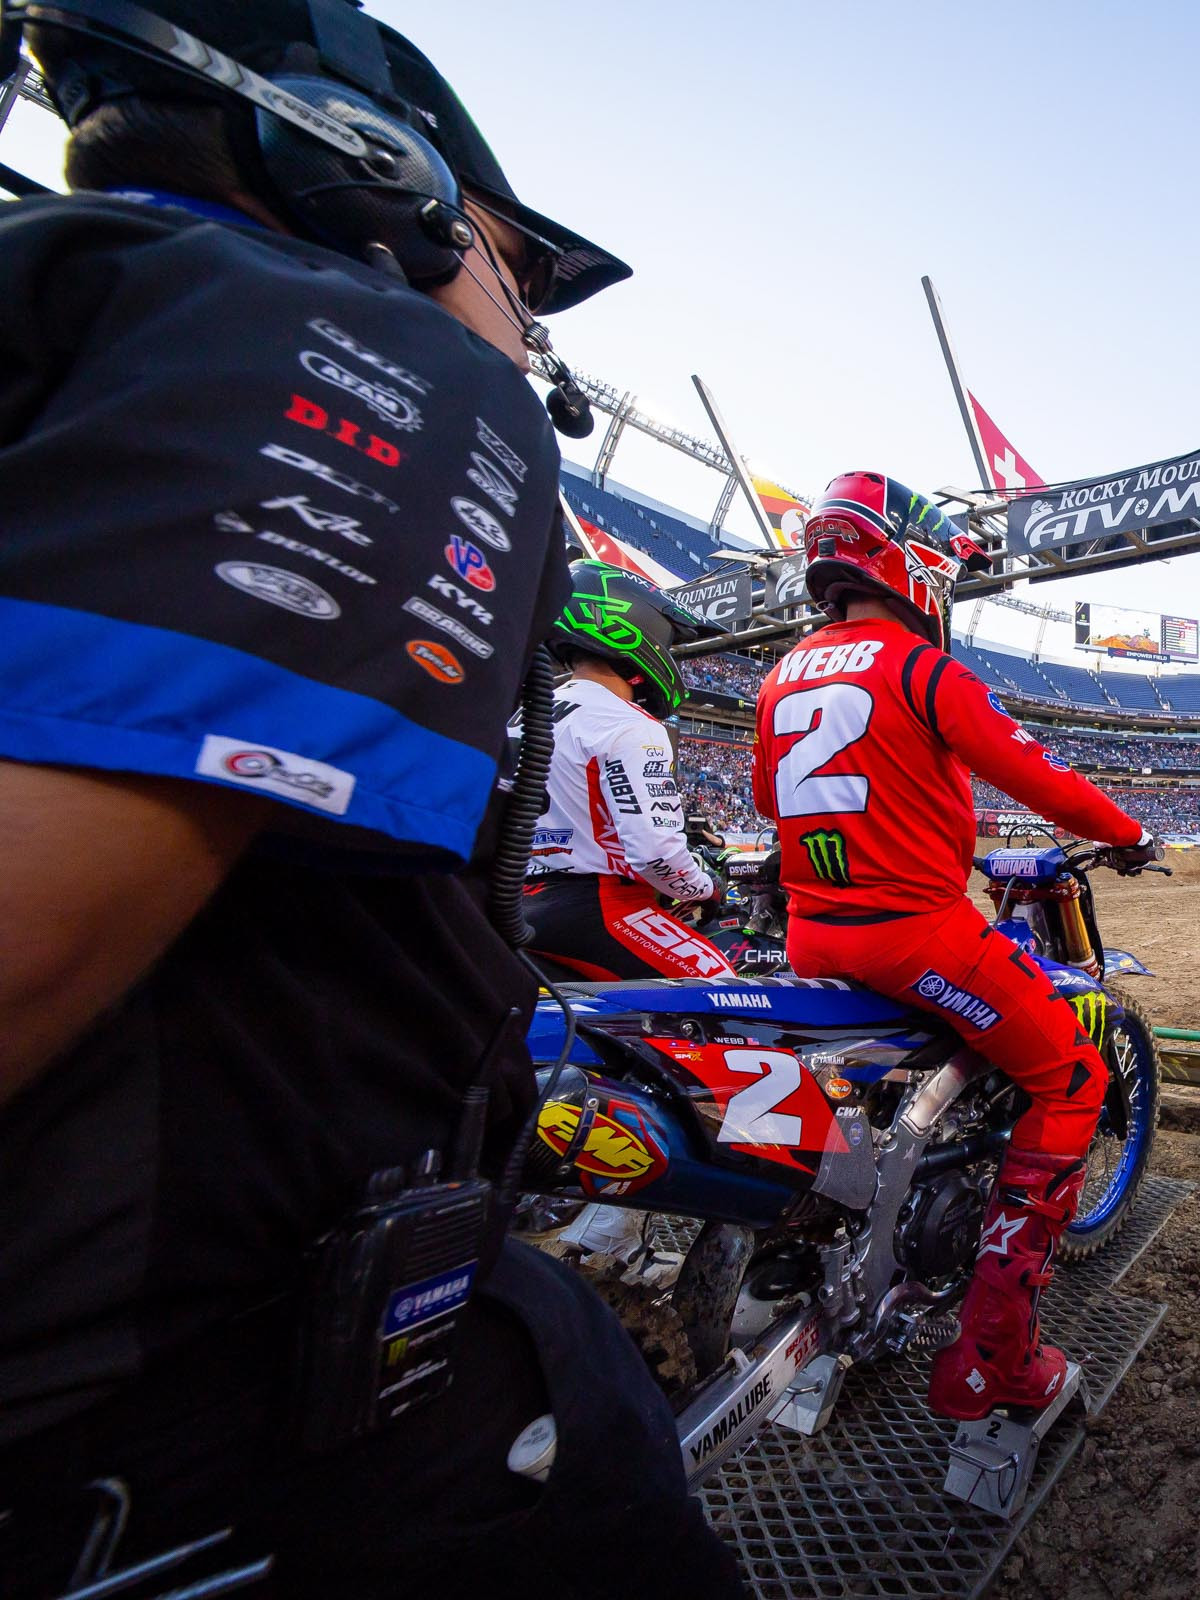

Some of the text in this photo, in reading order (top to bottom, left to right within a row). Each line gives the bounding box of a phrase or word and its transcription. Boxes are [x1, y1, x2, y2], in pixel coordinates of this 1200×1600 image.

[1057, 476, 1132, 511] ROCKY
[1029, 502, 1140, 549] ATV
[257, 530, 378, 585] DUNLOP
[409, 601, 490, 656] BRAKING
[776, 640, 884, 687] WEBB
[773, 682, 874, 819] 2
[729, 863, 759, 876] psychic
[992, 859, 1036, 875] PROTAPER
[677, 958, 698, 976] RACE
[708, 993, 772, 1009] YAMAHA
[937, 985, 999, 1031] YAMAHA
[714, 1036, 744, 1045] WEBB
[818, 1056, 845, 1065] YAMAHA
[716, 1049, 802, 1146] 2
[690, 1372, 773, 1464] YAMALUBE
[986, 1421, 1002, 1439] 2
